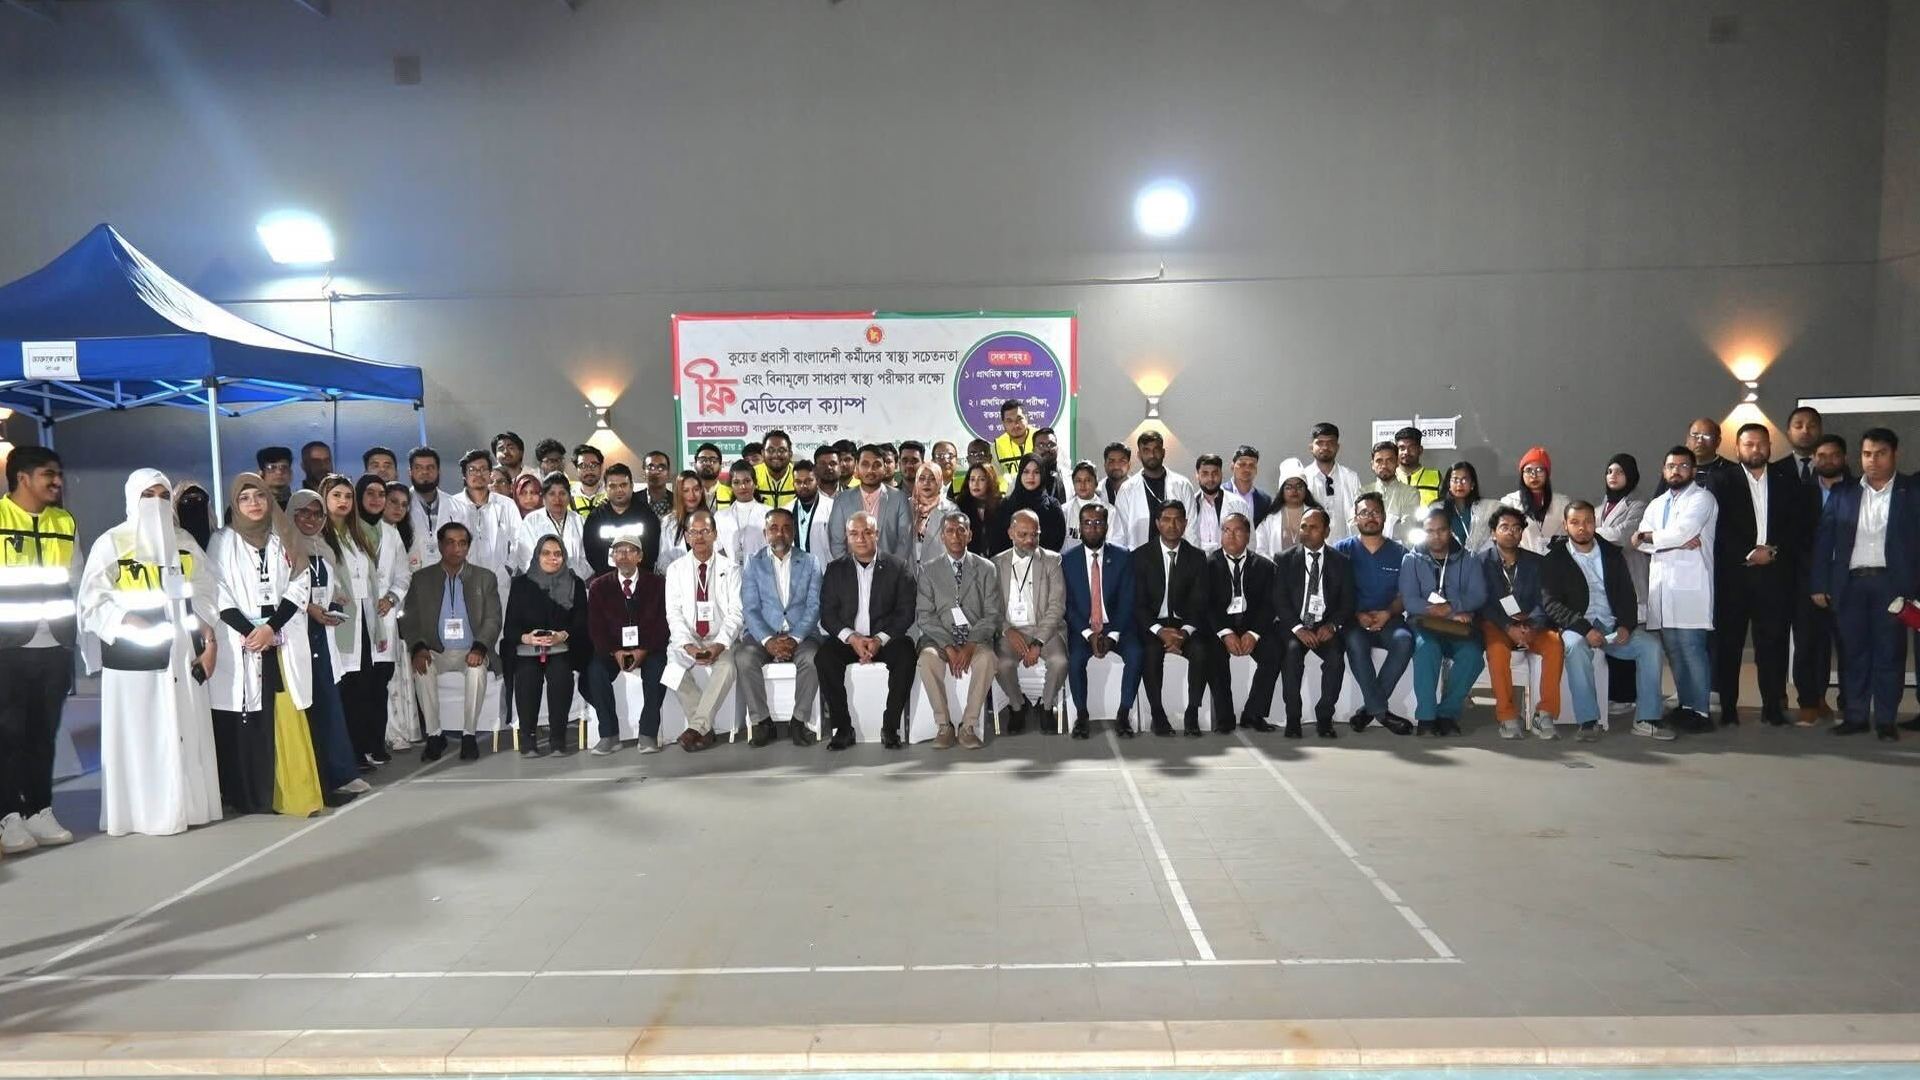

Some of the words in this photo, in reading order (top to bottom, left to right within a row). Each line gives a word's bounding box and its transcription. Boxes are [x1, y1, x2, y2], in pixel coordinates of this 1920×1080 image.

[728, 352, 758, 366] কুয়েত
[760, 347, 789, 363] প্রবাসী
[793, 347, 841, 364] বাংলাদেশী
[844, 347, 882, 363] কর্মীদের
[885, 351, 908, 366] স্বাস্থ্য
[912, 350, 959, 363] সচেতনতা
[742, 374, 763, 386] এবং
[766, 370, 809, 389] বিনামূল্যে
[812, 373, 847, 385] সাধারণ
[850, 373, 874, 388] স্বাস্থ্য
[877, 368, 915, 385] পরীক্ষার
[917, 373, 946, 385] লক্ষ্যে
[976, 368, 1002, 378] প্রাথমিক
[1022, 370, 1053, 378] সচেতনতা
[683, 357, 739, 416] ফ্রি
[741, 392, 813, 415] মেডিকেল
[817, 396, 867, 415] ক্যাম্প
[1421, 428, 1453, 437] ওয়াফরা
